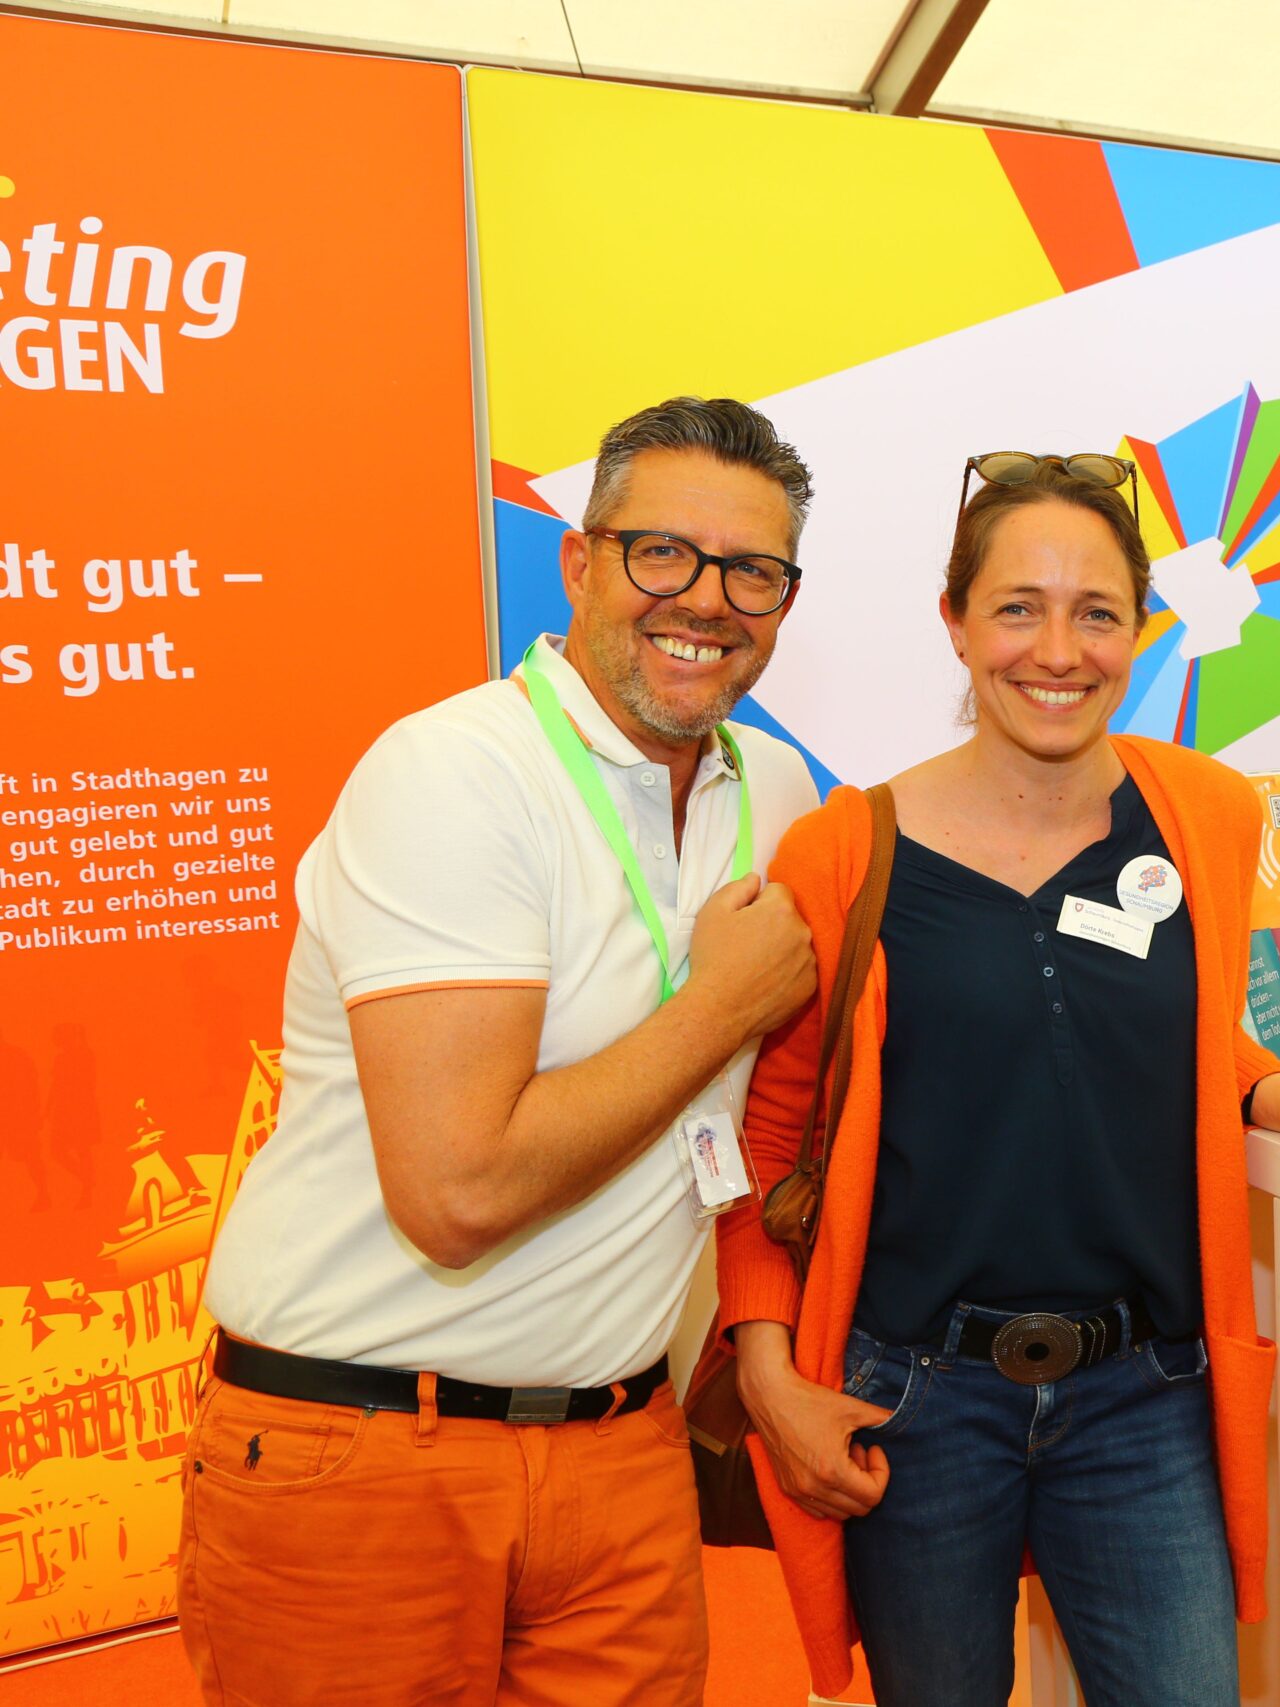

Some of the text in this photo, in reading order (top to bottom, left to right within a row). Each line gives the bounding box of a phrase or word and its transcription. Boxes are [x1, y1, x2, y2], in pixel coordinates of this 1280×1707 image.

[0, 315, 165, 394] GEN
[82, 548, 201, 613] gut
[58, 632, 195, 697] gut.
[31, 772, 58, 793] in
[71, 767, 227, 792] Stadthagen
[238, 767, 268, 783] zu
[1, 795, 272, 829] engagieren wir uns
[10, 823, 274, 862] gut gelebt und gut
[0, 852, 276, 888] hen, durch gezielte
[62, 898, 94, 916] zu
[106, 886, 216, 912] erhöhen
[228, 879, 277, 903] und
[0, 911, 280, 950] Publikum interessant
[1249, 957, 1264, 971] annst
